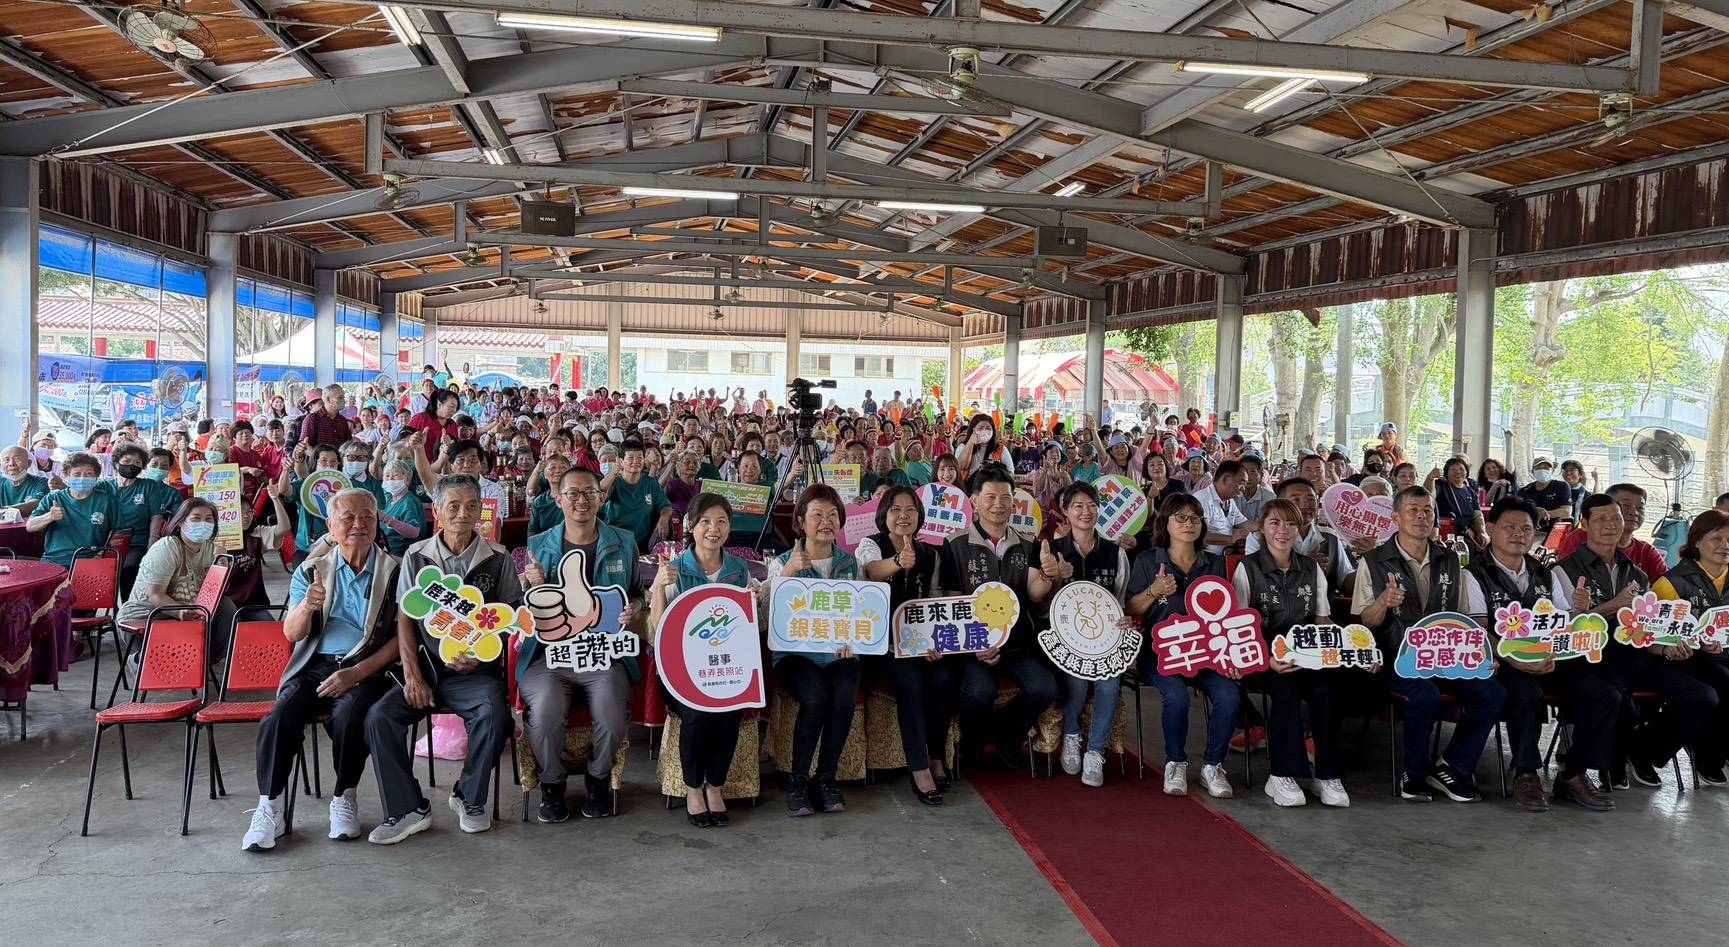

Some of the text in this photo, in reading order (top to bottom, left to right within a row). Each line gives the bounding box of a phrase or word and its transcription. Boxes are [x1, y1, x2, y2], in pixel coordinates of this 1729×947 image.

[218, 490, 236, 501] 150
[220, 511, 237, 521] 420
[424, 582, 476, 617] 鹿來越
[809, 590, 852, 613] 鹿草
[1066, 586, 1104, 599] LUCAO
[904, 600, 973, 625] 鹿來鹿
[1532, 612, 1565, 631] 活力
[1639, 615, 1650, 623] We
[1658, 603, 1689, 620] 青春
[788, 617, 873, 641] 銀髮寶貝
[931, 621, 991, 651] 健康
[1292, 625, 1343, 649] 越動
[1408, 627, 1484, 648] 甲您作伴
[1644, 624, 1667, 634] family
[1666, 620, 1694, 637] 永駐
[550, 634, 635, 669] 超讚的
[1041, 629, 1140, 676] 嘉義縣鹿草鄉公所
[1157, 612, 1264, 672] 幸福
[708, 653, 731, 666] 醫事
[1416, 647, 1483, 670] 足感心
[698, 666, 744, 678] 巷弄長照站
